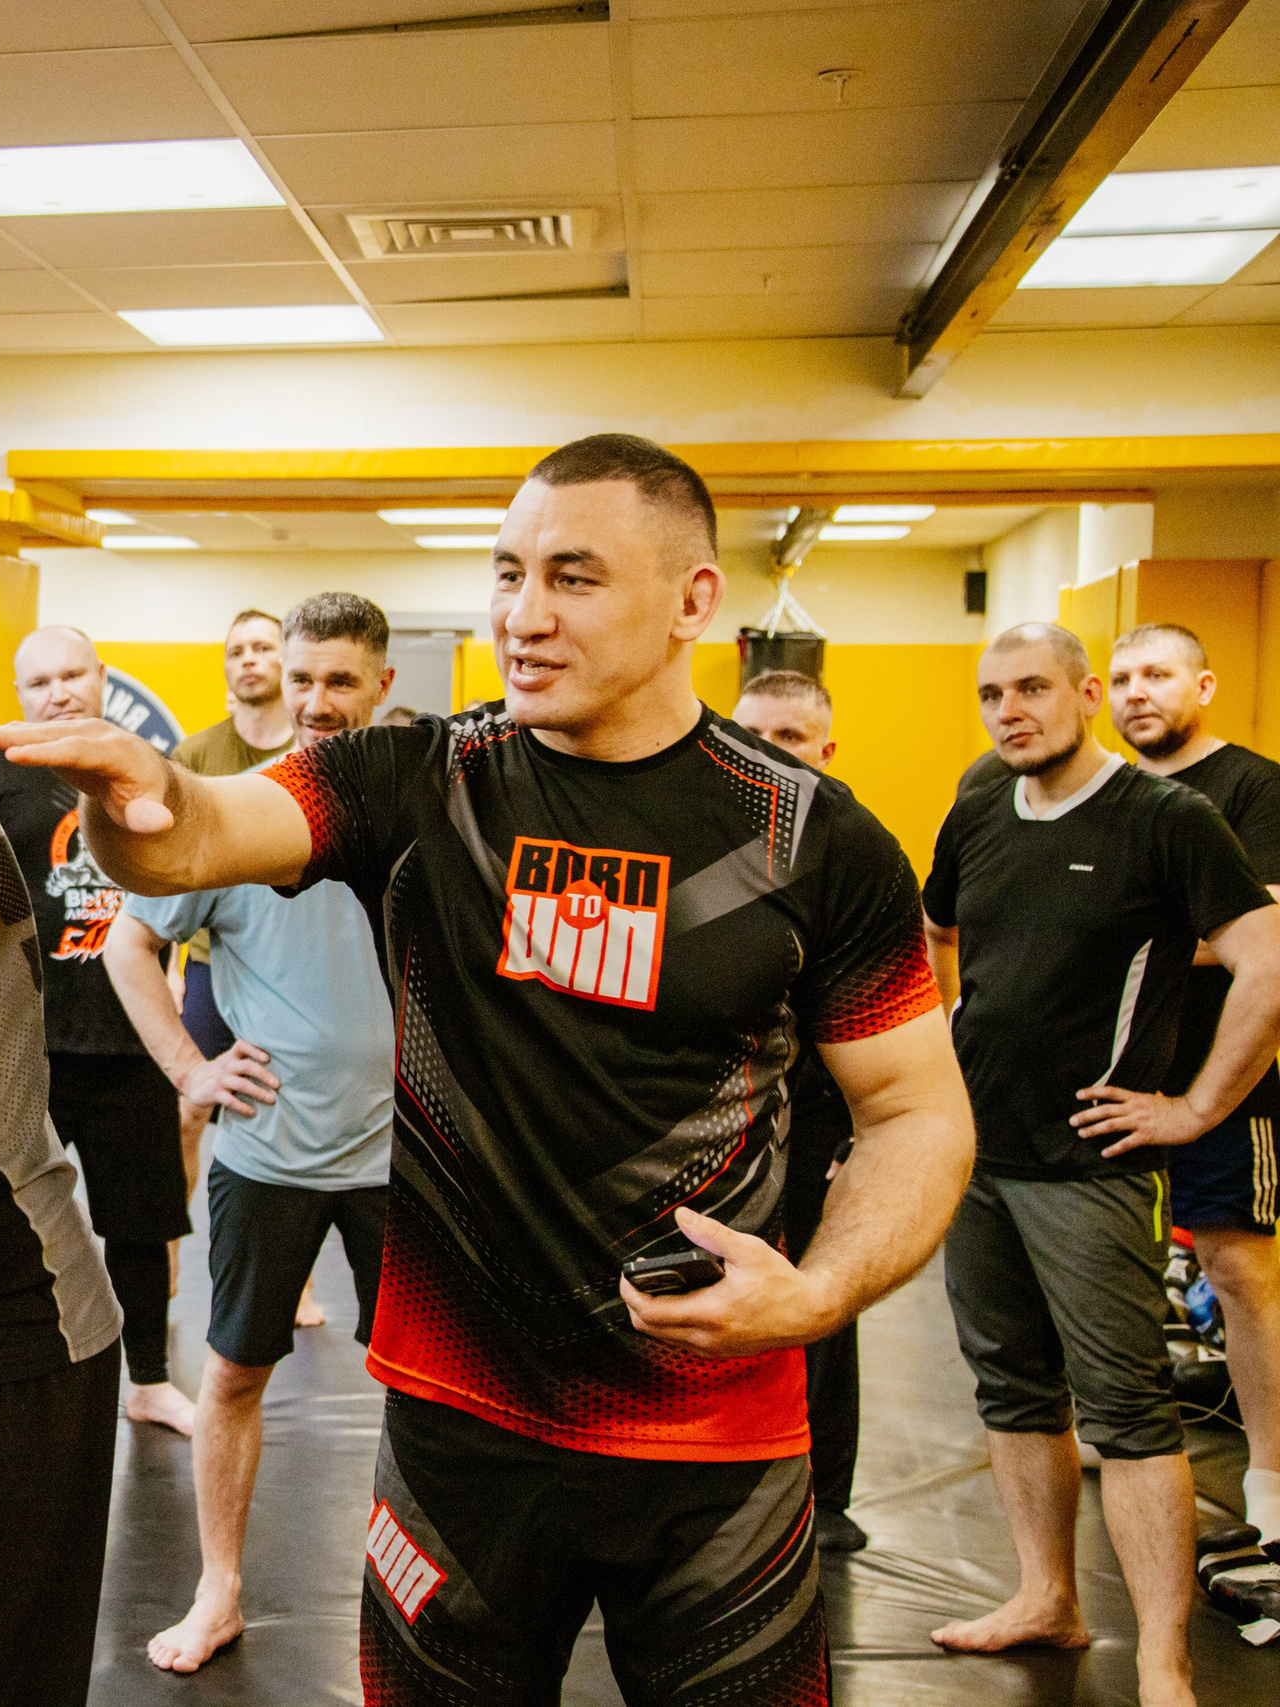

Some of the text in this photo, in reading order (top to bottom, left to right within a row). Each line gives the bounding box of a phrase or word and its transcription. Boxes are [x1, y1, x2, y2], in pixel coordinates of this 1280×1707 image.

[514, 844, 660, 908] BORN
[567, 893, 602, 918] TO
[505, 893, 657, 1003] WIN
[367, 1505, 441, 1618] WIN
